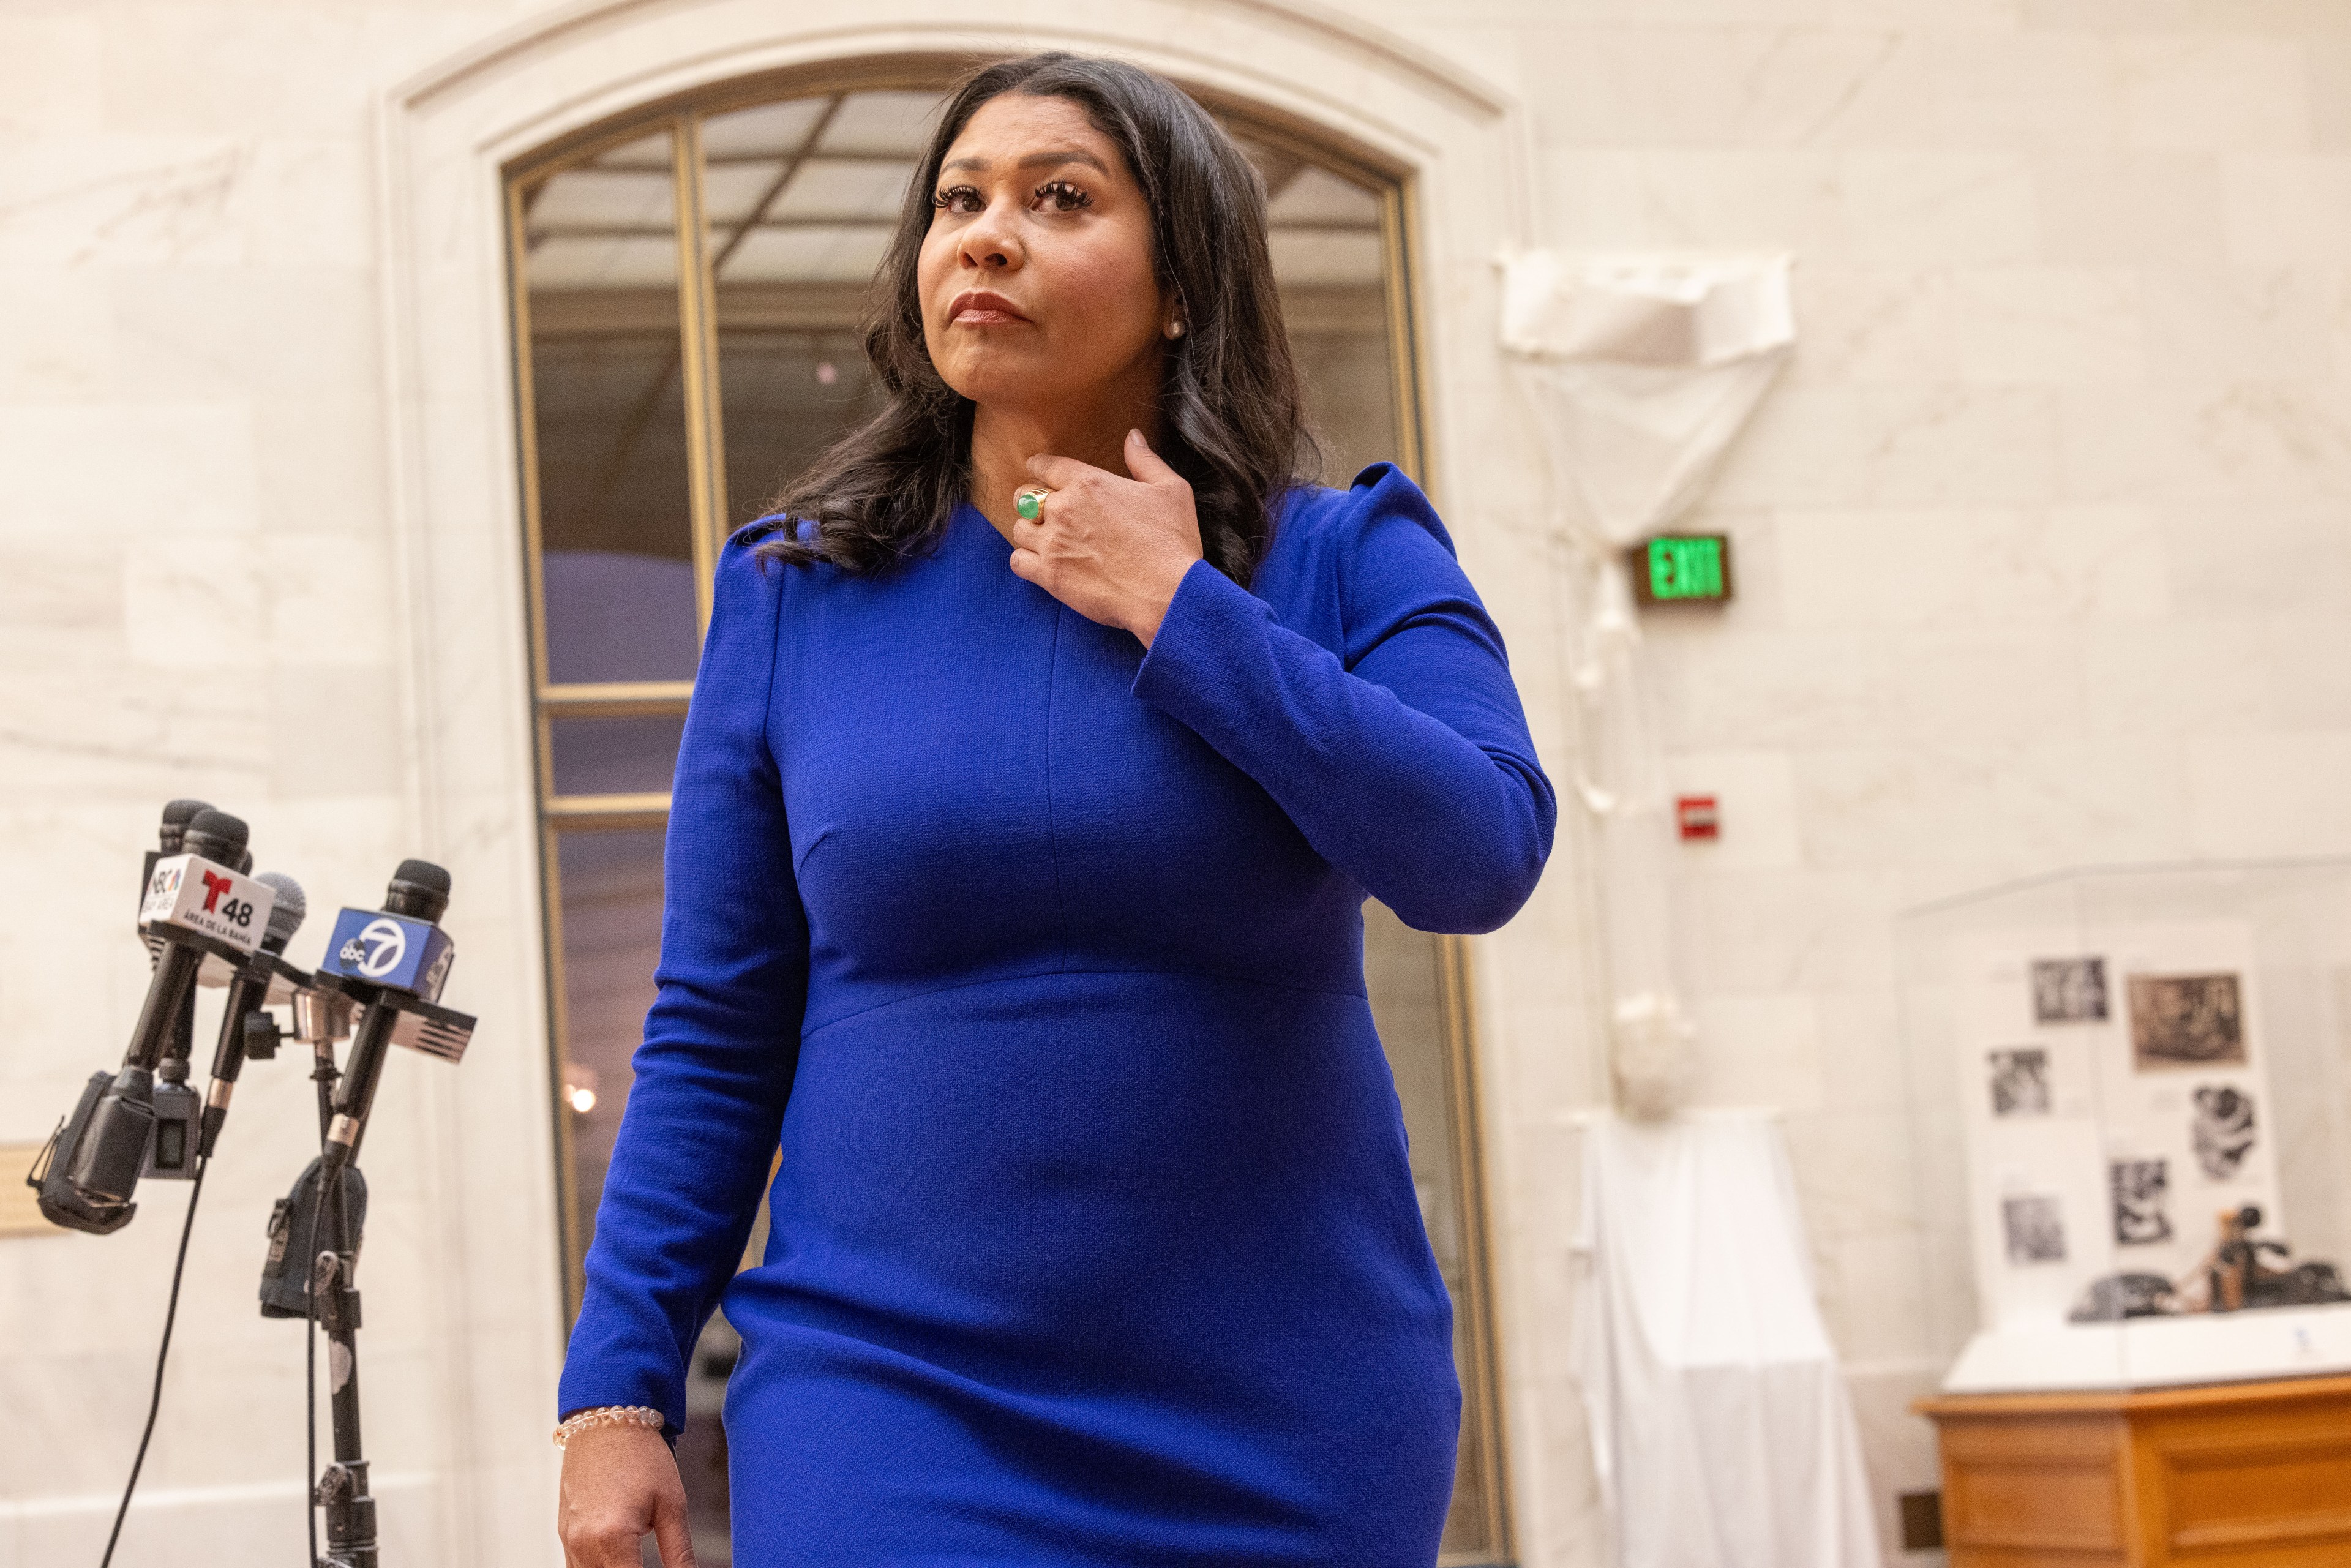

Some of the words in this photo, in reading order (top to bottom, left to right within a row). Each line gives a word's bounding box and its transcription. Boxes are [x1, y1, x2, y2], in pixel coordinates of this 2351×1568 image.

[1648, 536, 1722, 599] EXIT
[205, 919, 216, 931] DE
[217, 923, 227, 935] LA
[222, 898, 253, 928] 48
[340, 942, 366, 962] abc
[358, 921, 405, 977] 7
